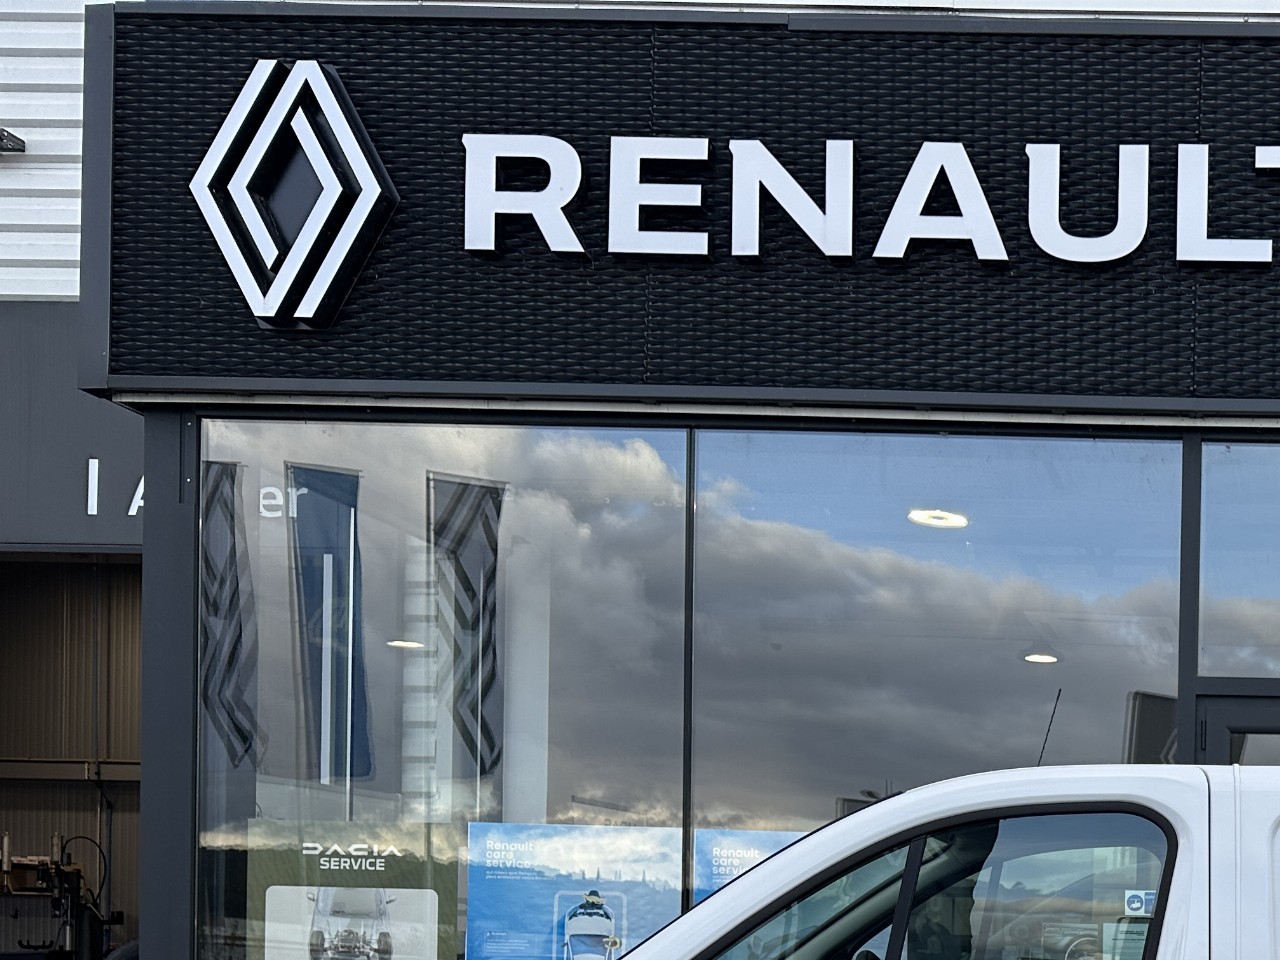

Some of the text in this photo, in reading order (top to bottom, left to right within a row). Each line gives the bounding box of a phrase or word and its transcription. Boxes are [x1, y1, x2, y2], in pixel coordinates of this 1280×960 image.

[302, 842, 403, 857] DACIA
[486, 840, 534, 851] Renault
[486, 850, 514, 859] care
[712, 847, 760, 858] Renault
[319, 857, 386, 871] SERVICE
[485, 858, 531, 868] service
[712, 857, 740, 866] care
